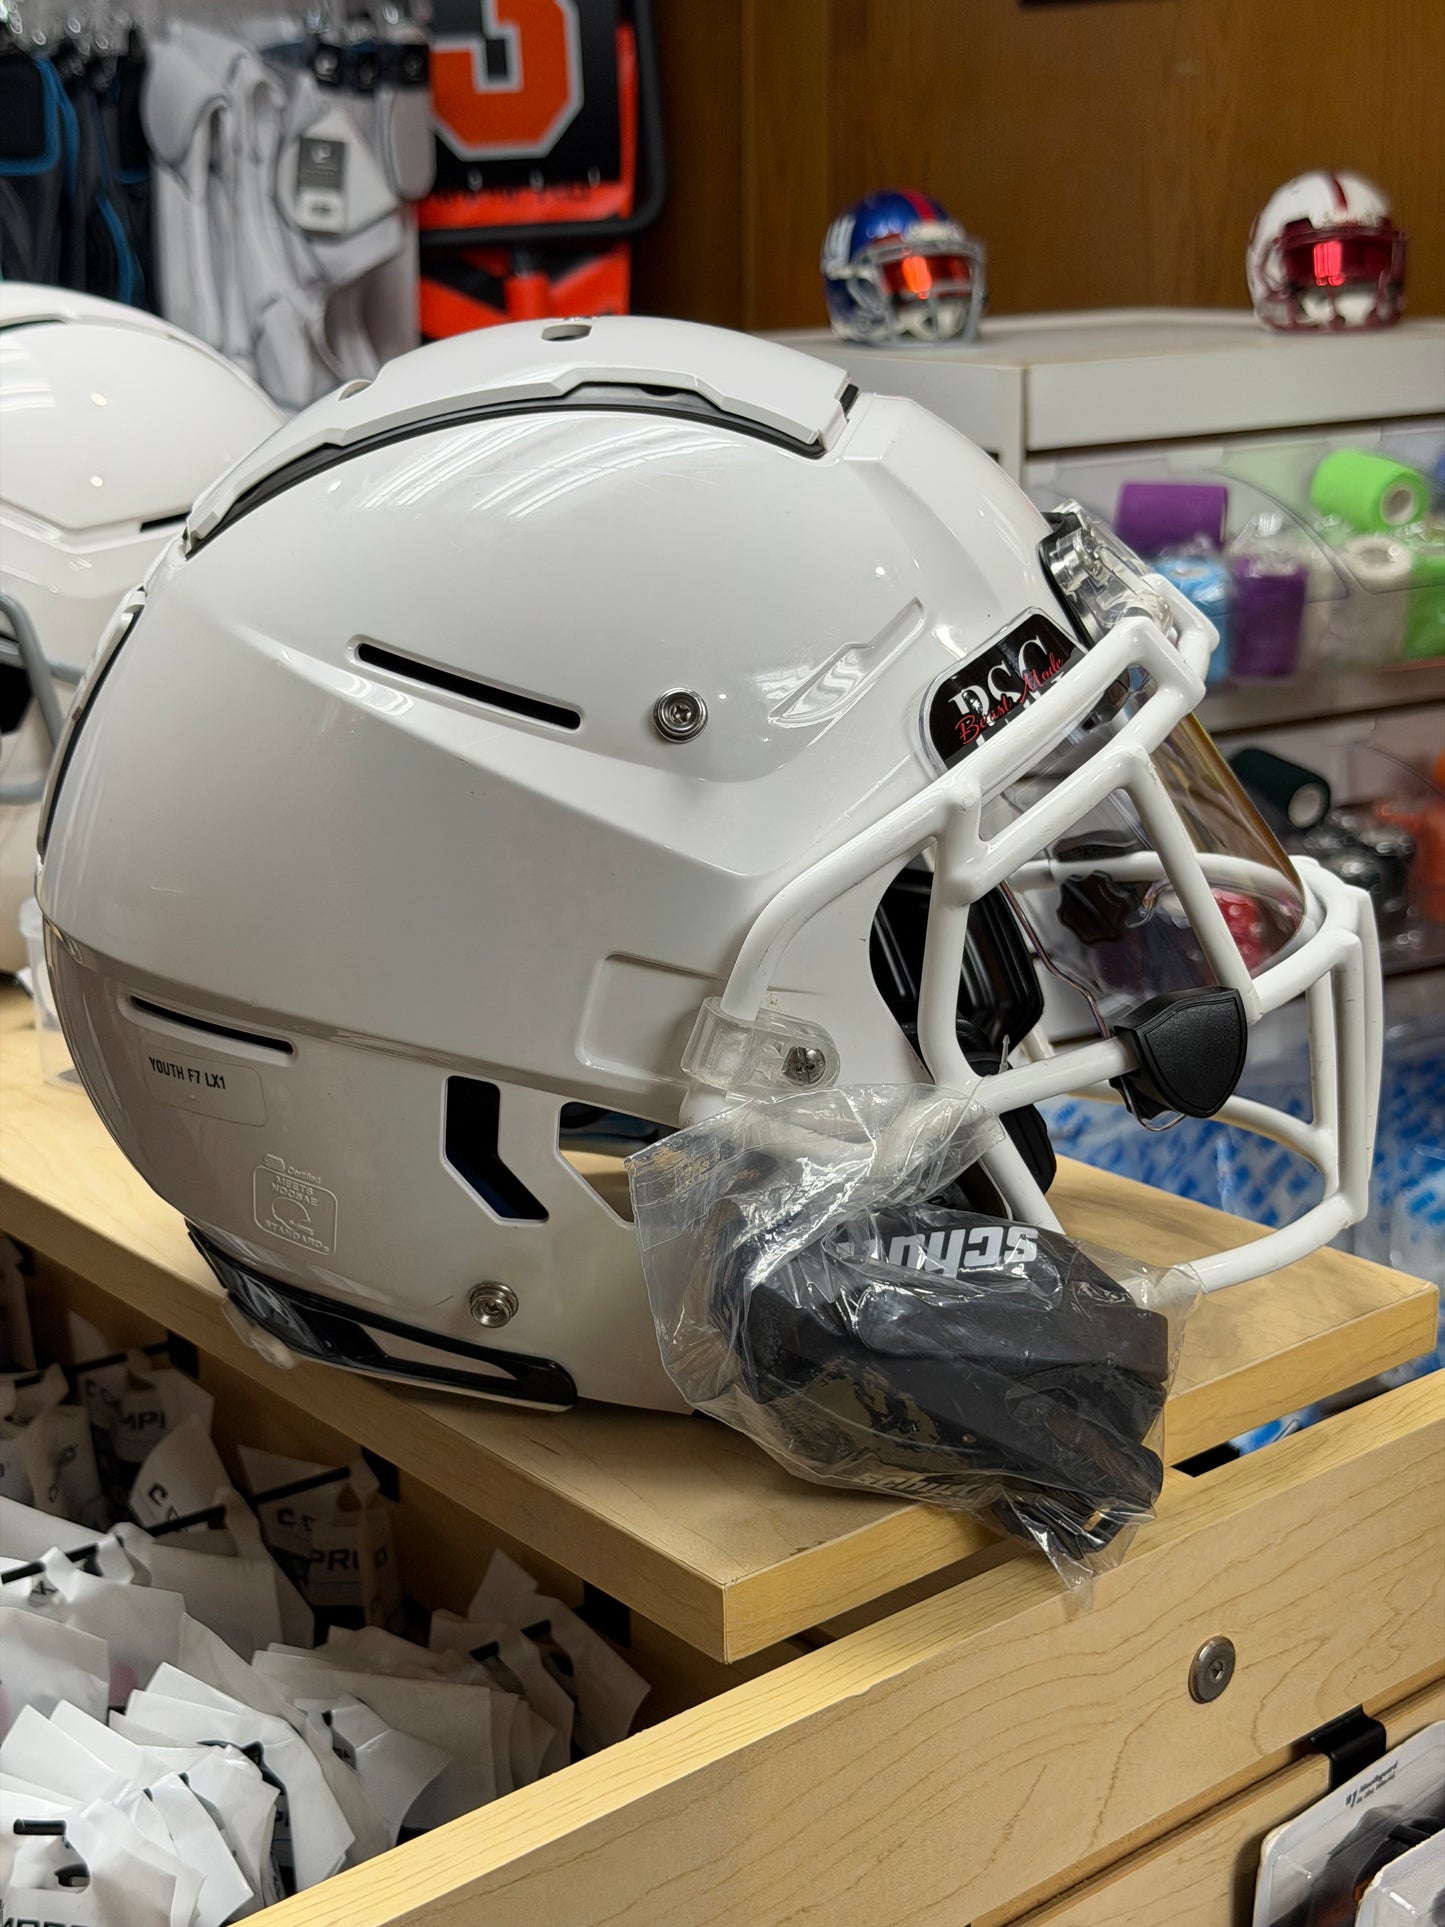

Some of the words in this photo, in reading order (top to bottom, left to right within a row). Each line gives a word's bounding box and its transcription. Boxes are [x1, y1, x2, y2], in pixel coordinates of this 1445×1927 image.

[954, 694, 1013, 745] Beast
[1018, 652, 1063, 704] Mode
[149, 1055, 185, 1081] YOUTH
[187, 1068, 201, 1085] F7
[204, 1072, 226, 1090] LX1
[271, 1182, 319, 1208] NOCSAE
[276, 1175, 314, 1196] MEETS
